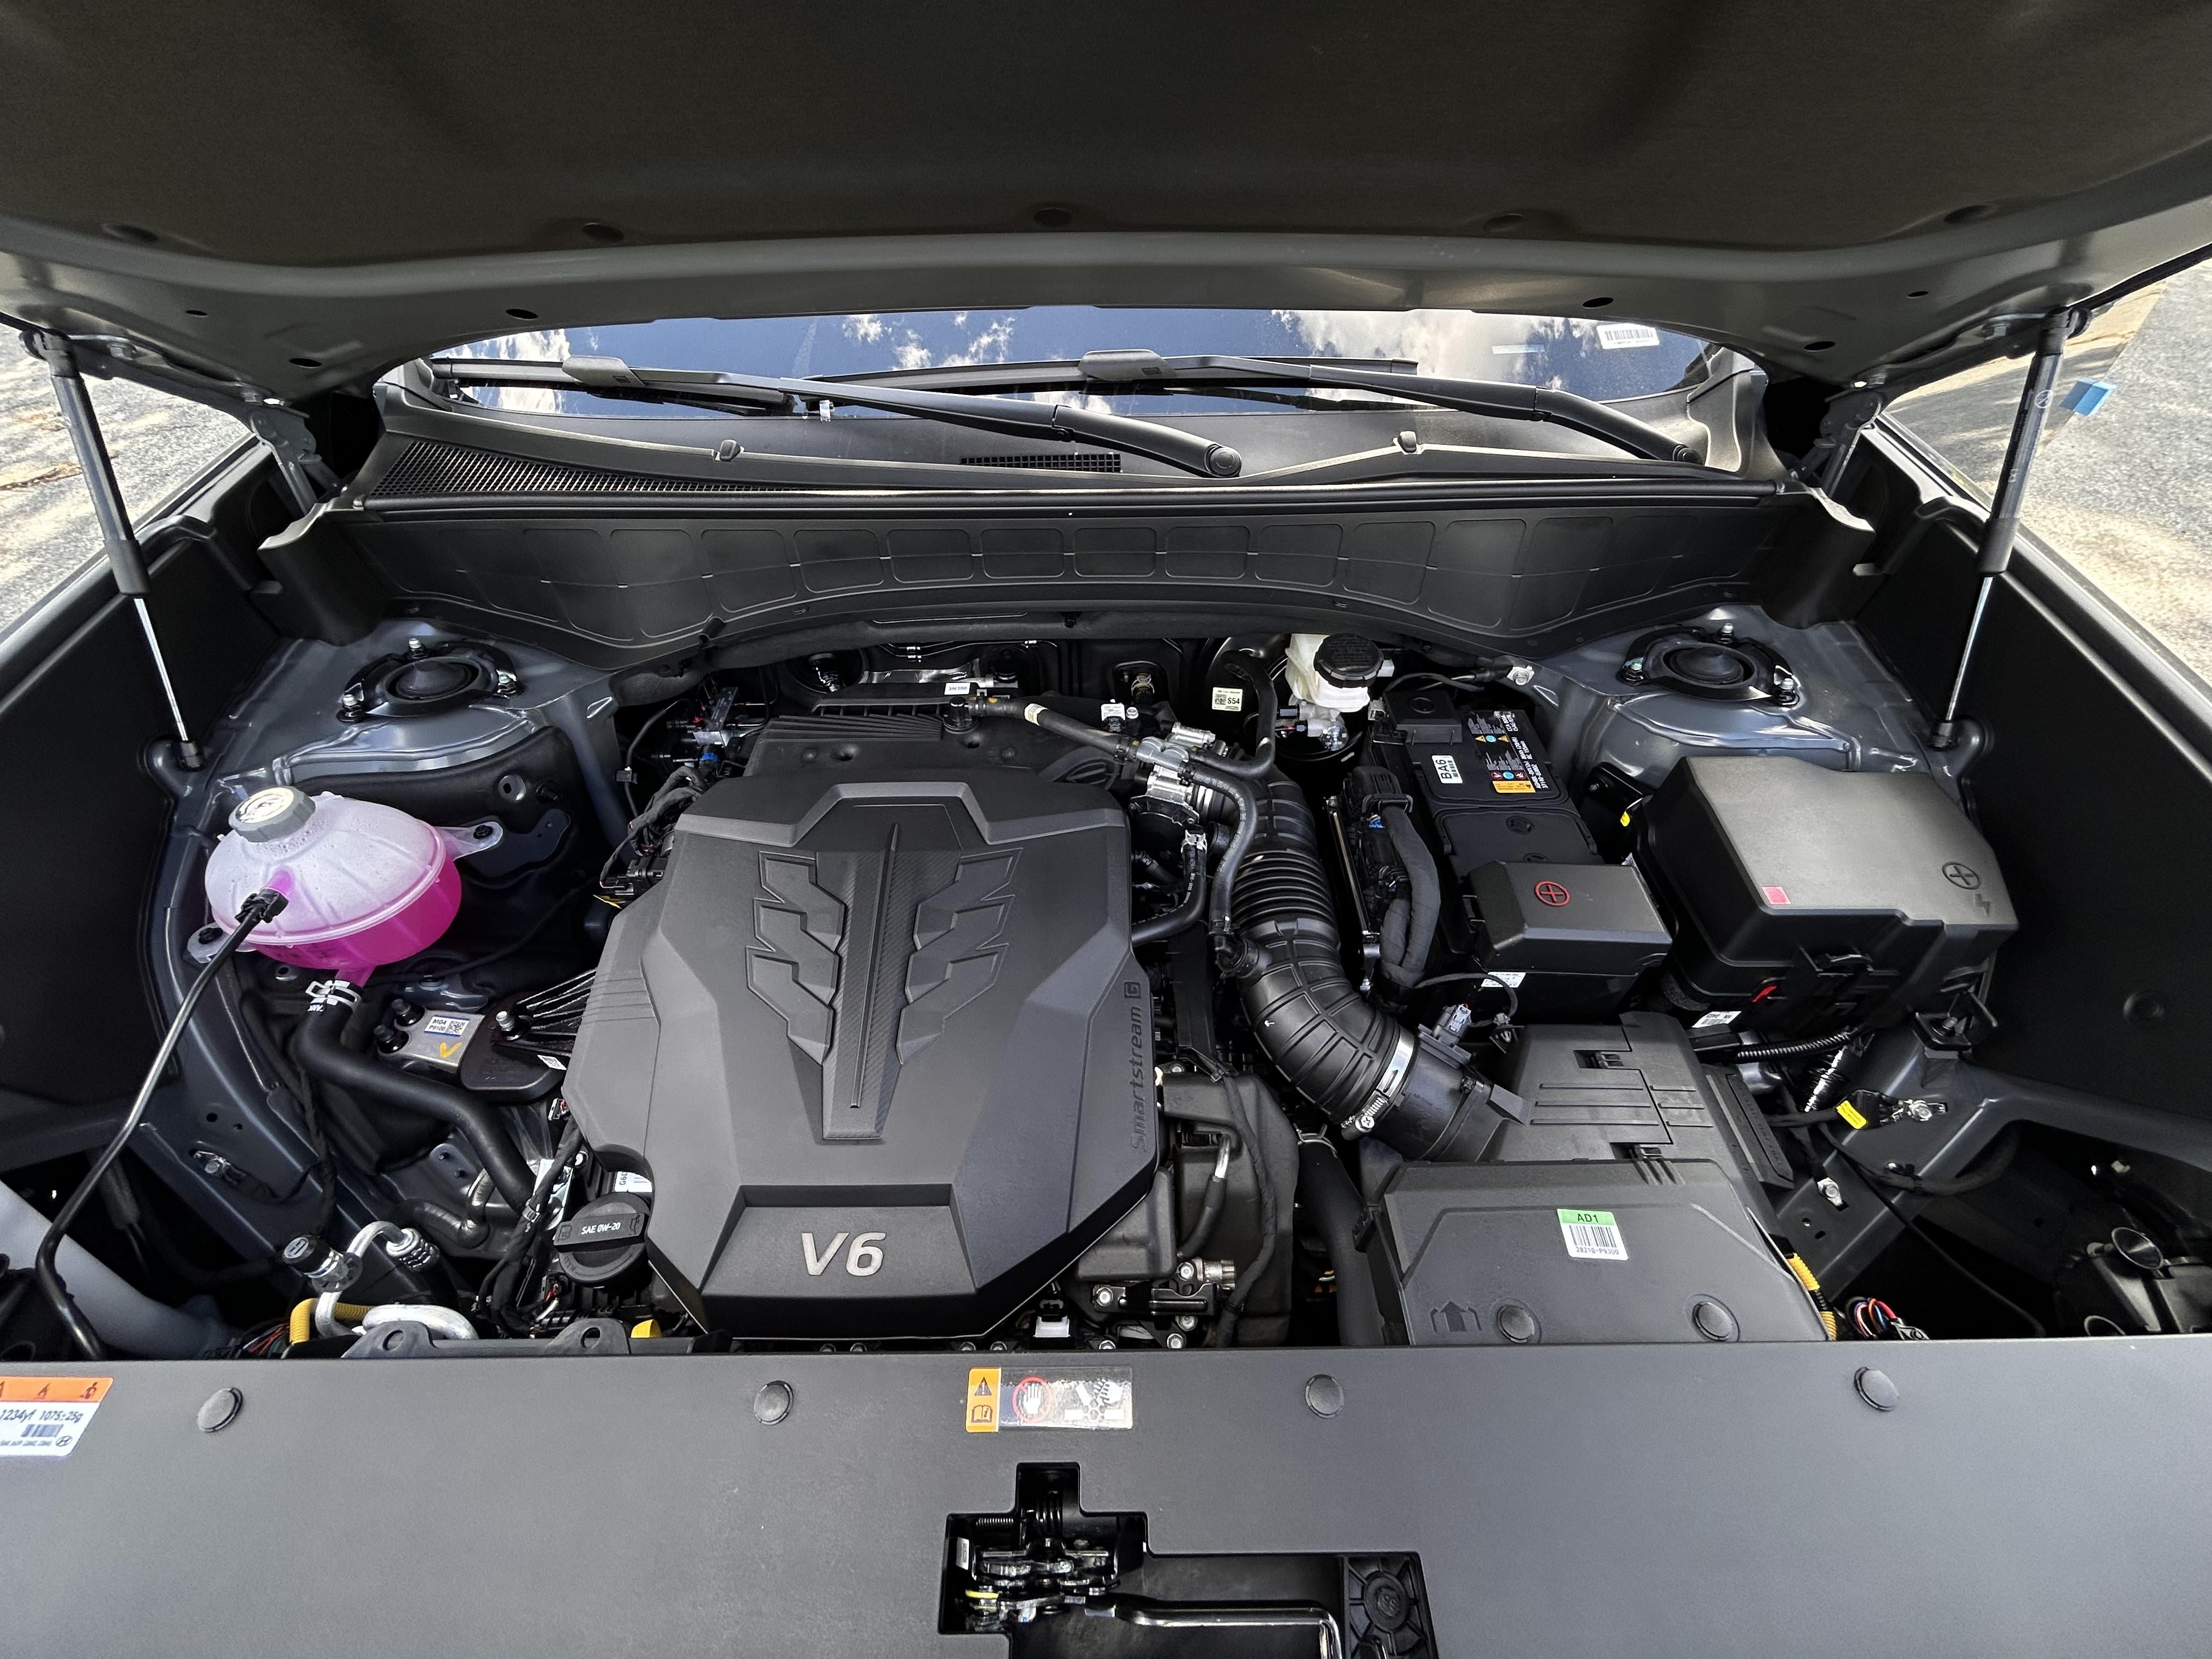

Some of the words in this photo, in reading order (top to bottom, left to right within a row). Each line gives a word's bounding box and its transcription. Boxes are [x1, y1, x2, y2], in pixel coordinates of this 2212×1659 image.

[1435, 759, 1453, 779] BA6
[1128, 1006, 1147, 1154] Smartstream
[1577, 1213, 1599, 1223] AD1
[580, 1226, 596, 1235] SAE
[597, 1222, 621, 1233] 0W-20
[802, 1232, 887, 1277] V6
